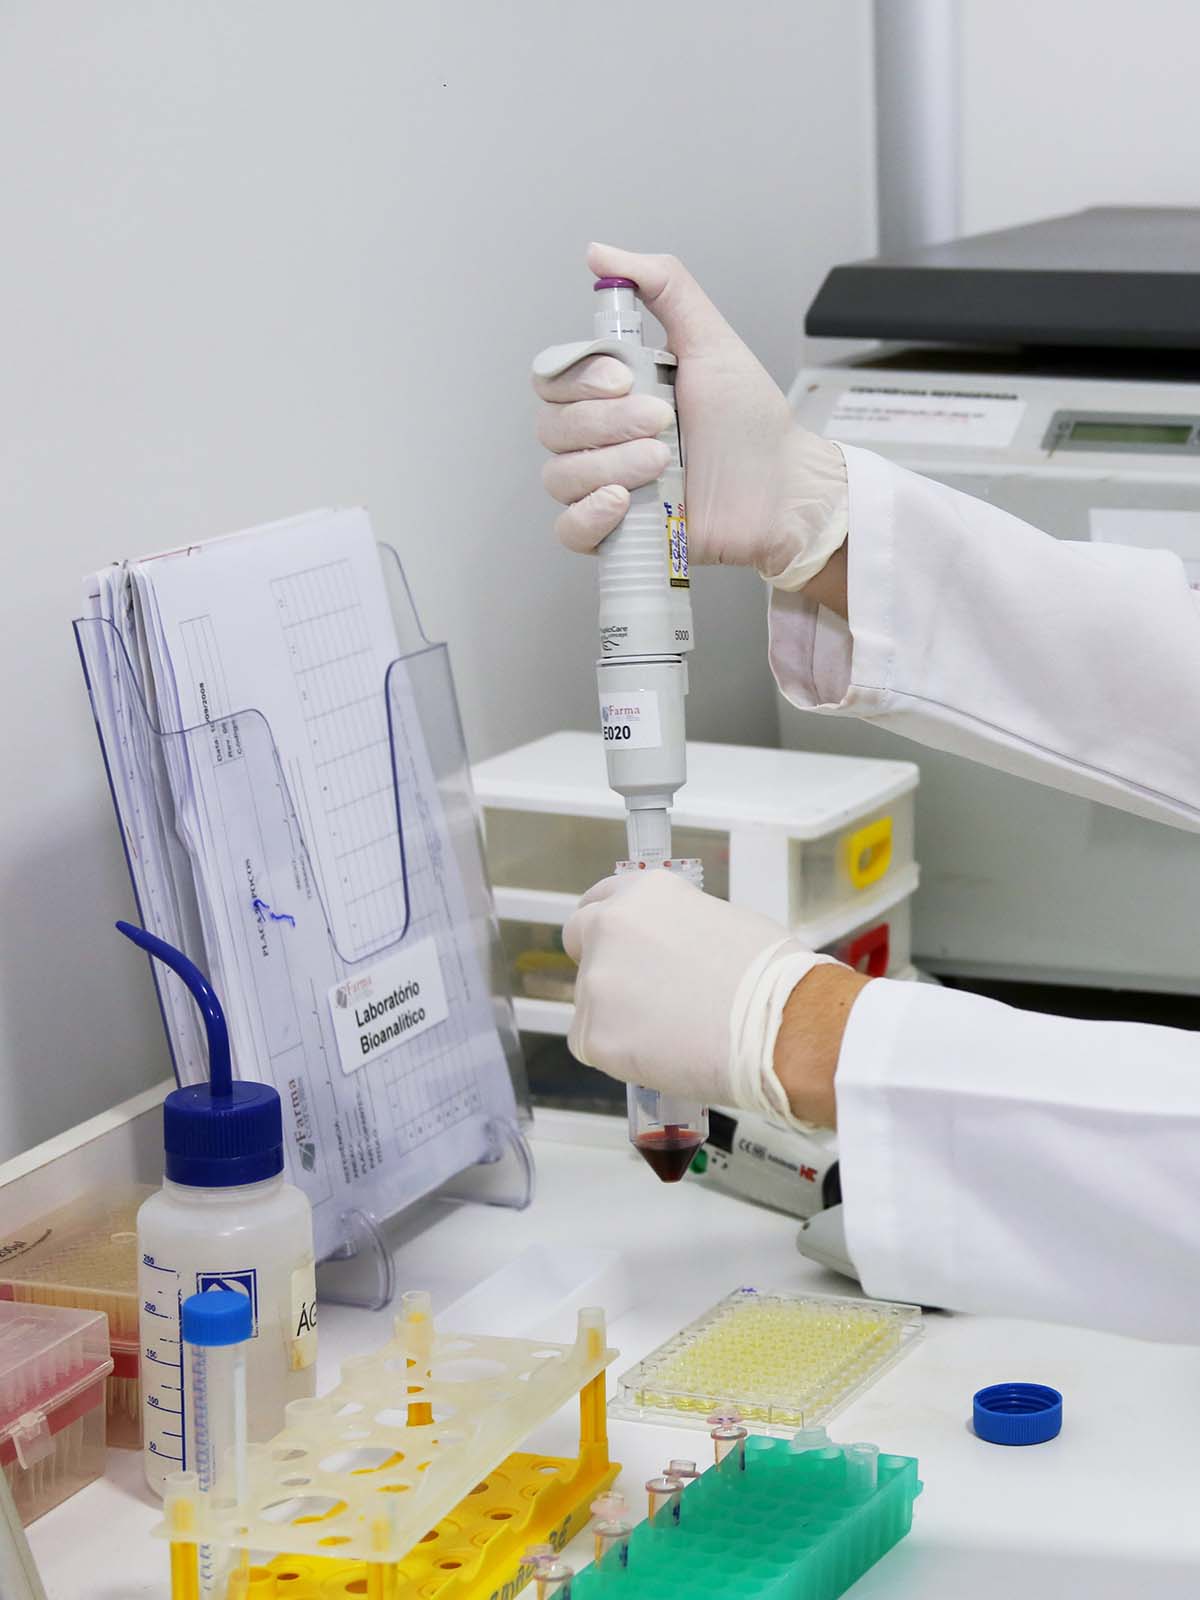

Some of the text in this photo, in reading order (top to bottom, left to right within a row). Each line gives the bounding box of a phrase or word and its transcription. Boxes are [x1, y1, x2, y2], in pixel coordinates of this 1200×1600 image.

[674, 630, 690, 640] 5000
[603, 724, 631, 740] E020
[355, 981, 420, 1028] Laboratório
[360, 1007, 426, 1054] Bioanalítico
[143, 1254, 155, 1265] 250
[145, 1301, 156, 1312] 200
[148, 1396, 159, 1406] 100
[150, 1441, 157, 1451] 50
